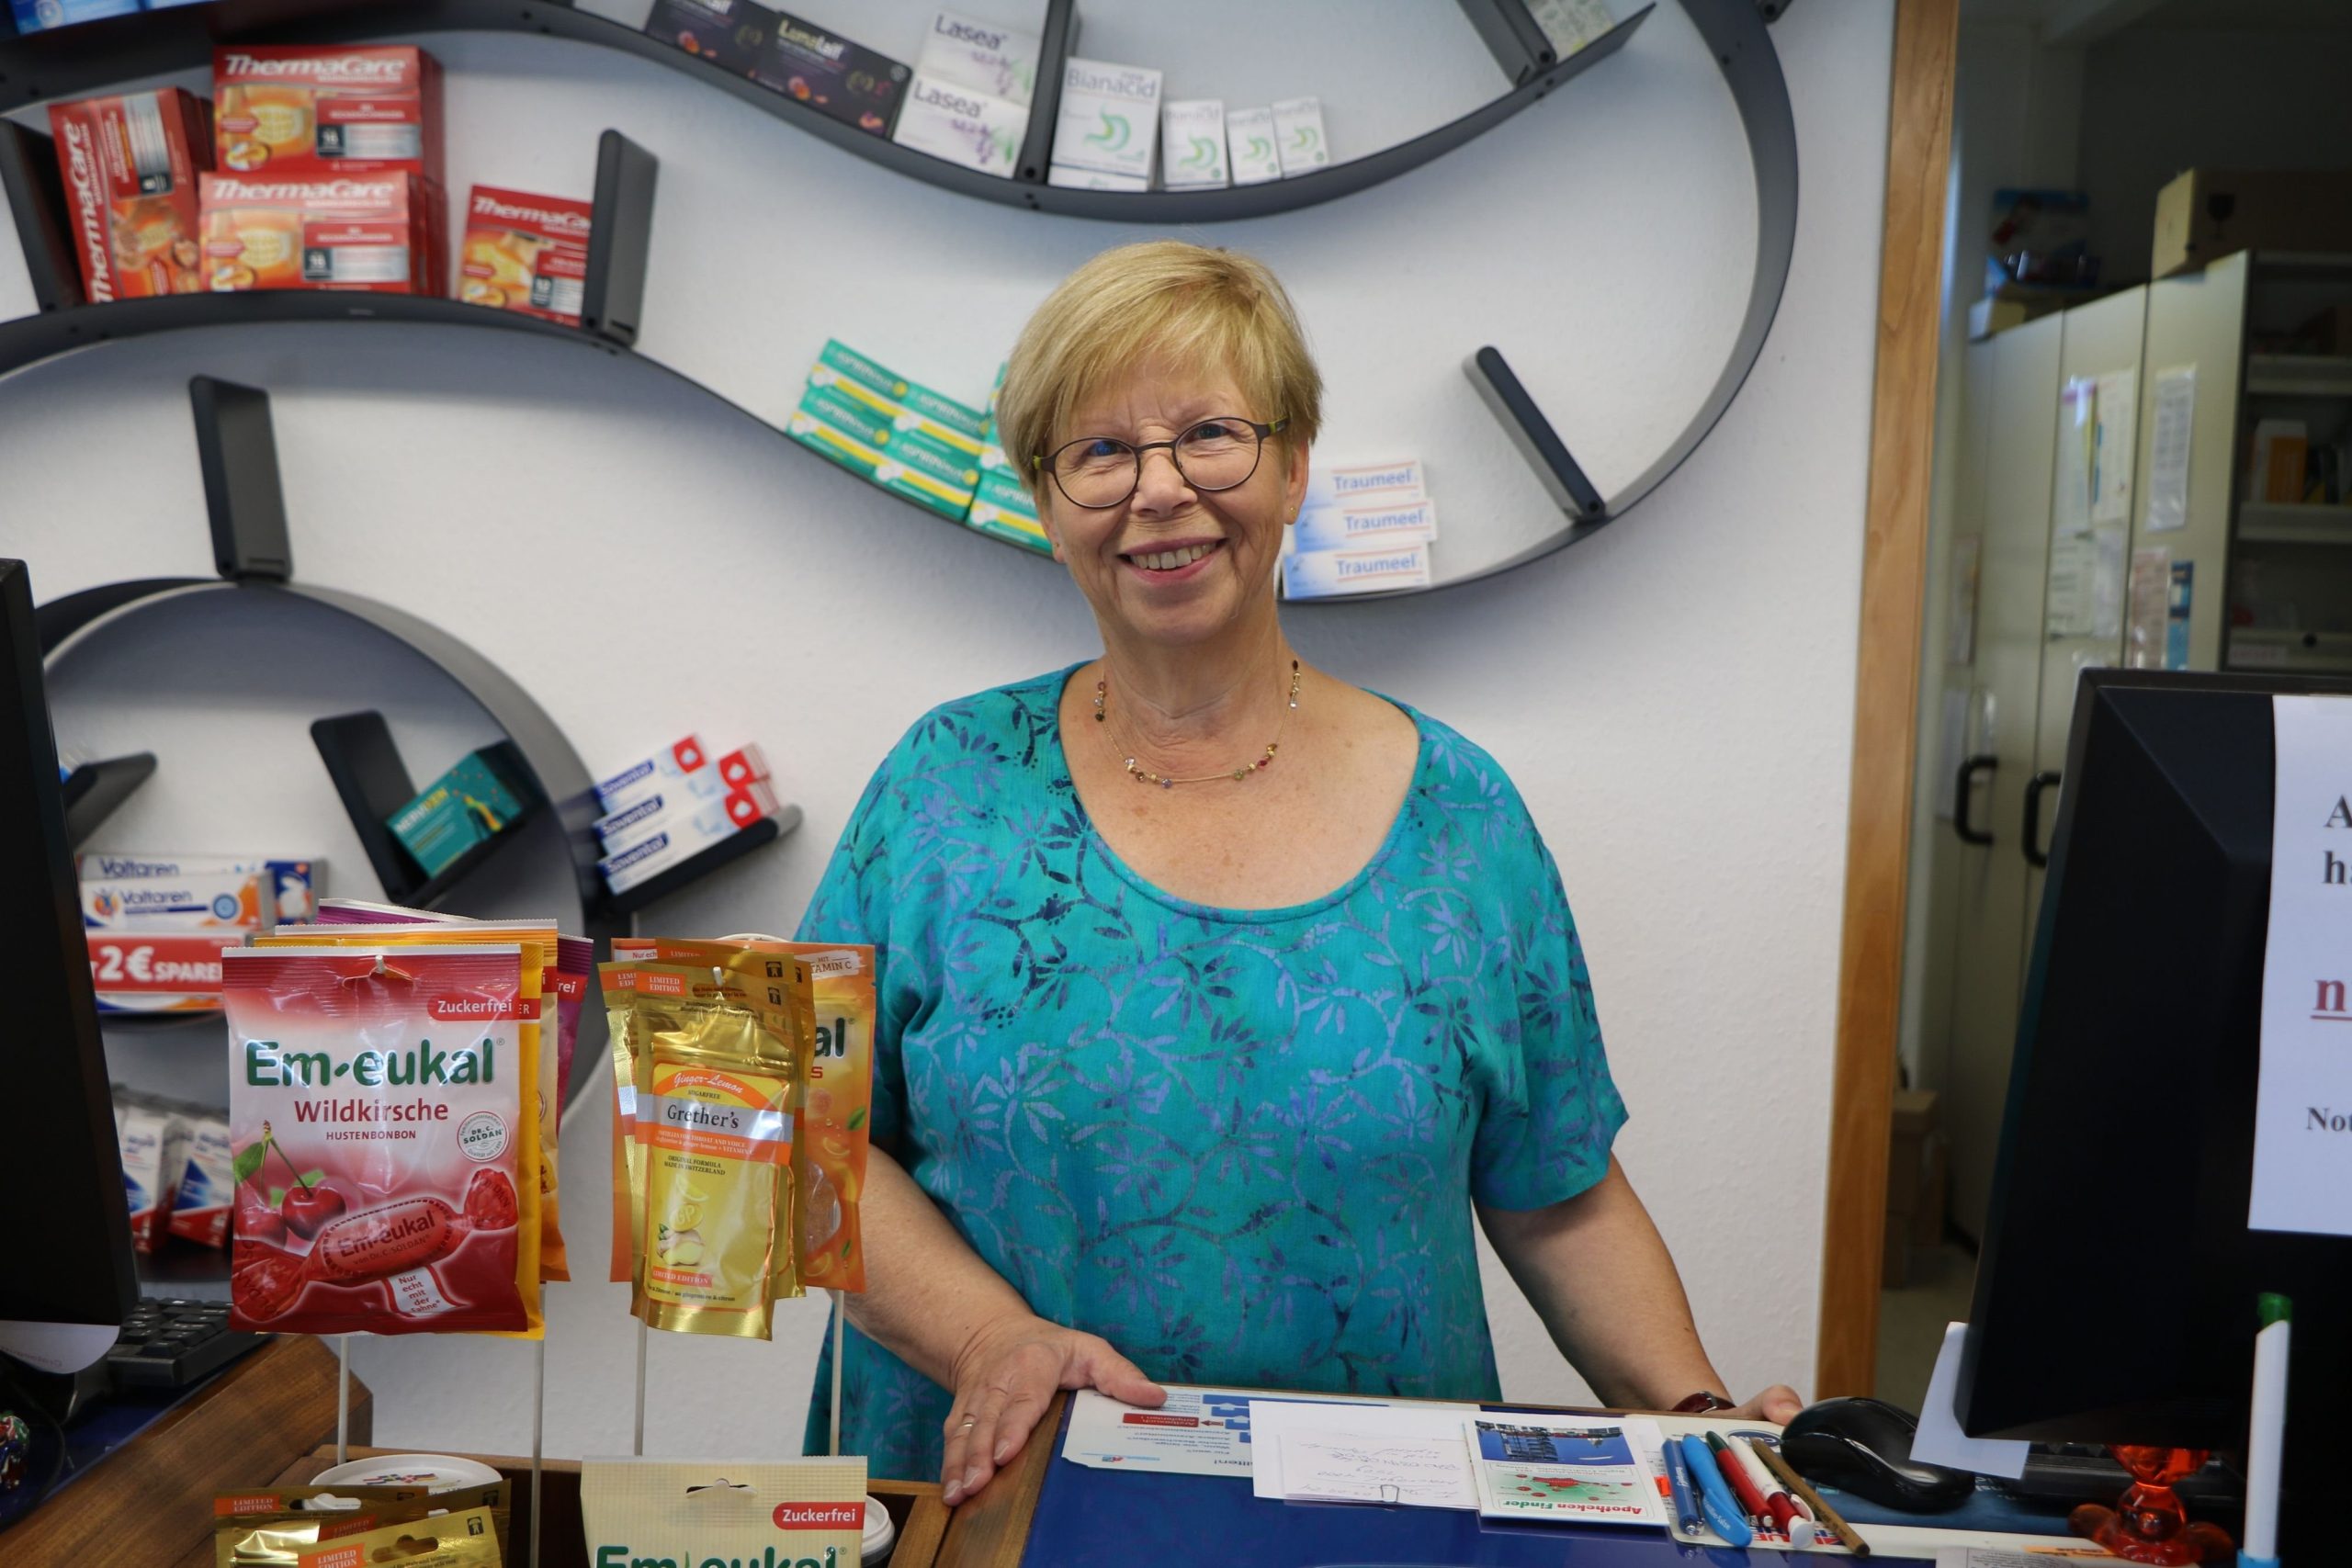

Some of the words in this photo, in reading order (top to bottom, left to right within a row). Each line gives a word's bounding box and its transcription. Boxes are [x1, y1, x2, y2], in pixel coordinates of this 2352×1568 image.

[934, 14, 1002, 50] Lasea
[225, 54, 407, 75] ThermaCare
[1066, 67, 1157, 98] Bianacid
[913, 81, 982, 118] Lasea
[212, 179, 396, 200] ThermaCare
[63, 120, 113, 303] ThermaCare
[473, 195, 592, 229] ThermaCa
[1333, 468, 1412, 491] Traumeel
[1345, 508, 1424, 531] Traumeel
[1336, 553, 1417, 576] Traumeel
[99, 858, 179, 877] Voltaren
[120, 889, 192, 905] Voltaren
[844, 961, 853, 970] C
[649, 976, 680, 986] LIMITED
[650, 983, 681, 993] EDITION
[437, 999, 513, 1014] Zuckerfrei
[245, 1037, 494, 1088] Em-eukal
[673, 1072, 743, 1095] Ginger-Lemon
[687, 1089, 721, 1100] SUGARFREE
[294, 1098, 449, 1123] Wildkirsche
[326, 1130, 417, 1141] HUSTENBONBON
[463, 1129, 503, 1145] SOLDAN
[728, 1139, 746, 1148] VOICE
[668, 1155, 692, 1165] ORIGINAL
[693, 1158, 721, 1168] FORMULA
[684, 1164, 726, 1176] SWITZERLAND
[338, 1210, 435, 1258] Em-eukal
[398, 1275, 416, 1284] Nur
[676, 1273, 708, 1284] EDITION
[402, 1281, 424, 1292] echt
[409, 1290, 426, 1299] mit
[414, 1297, 429, 1305] der
[233, 1497, 273, 1506] LIMITED
[233, 1504, 274, 1513] EDITION
[1503, 1500, 1553, 1510] Finder
[1557, 1503, 1643, 1515] Apotheken
[782, 1508, 856, 1522] Zuckerfrei
[317, 1549, 357, 1564] LIMITED
